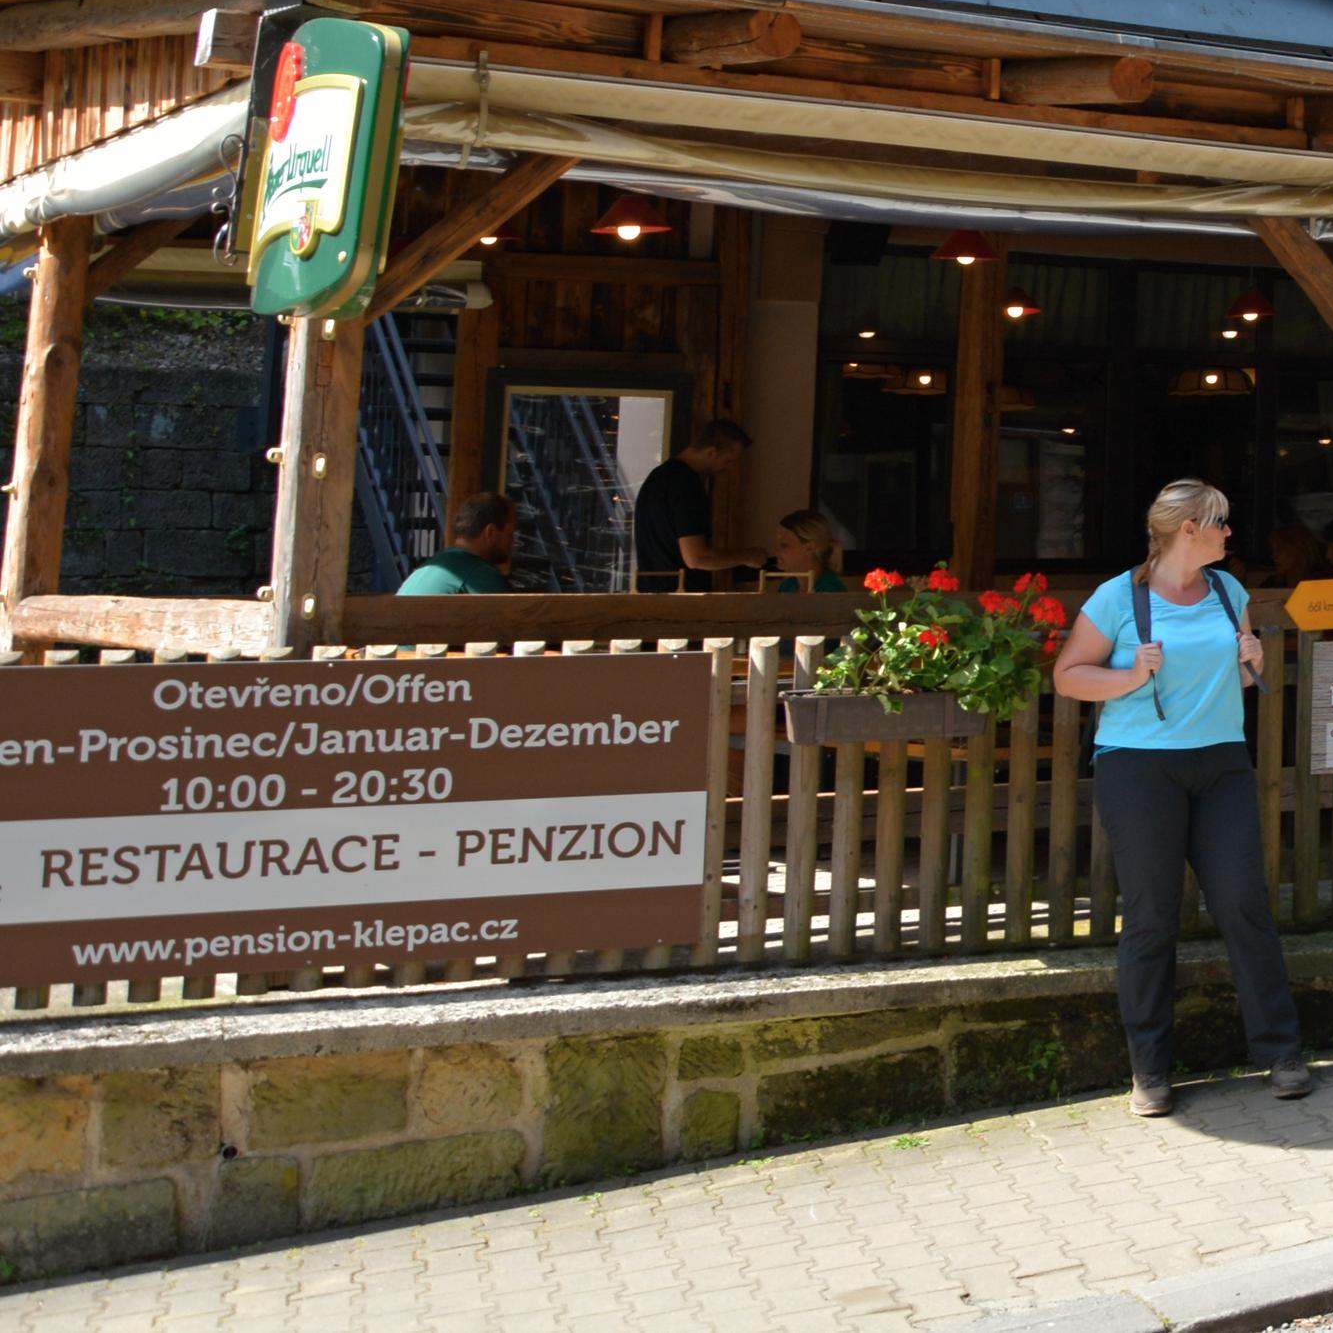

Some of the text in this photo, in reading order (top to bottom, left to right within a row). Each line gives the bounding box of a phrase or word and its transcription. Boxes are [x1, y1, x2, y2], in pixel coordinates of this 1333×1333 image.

[152, 673, 473, 711] Otevřeno/Offen
[160, 772, 287, 813] 10:00
[331, 767, 453, 806] 20:30
[40, 832, 401, 889] RESTAURACE
[455, 818, 687, 868] PENZION
[72, 916, 519, 966] www.pension-klepac.cz
